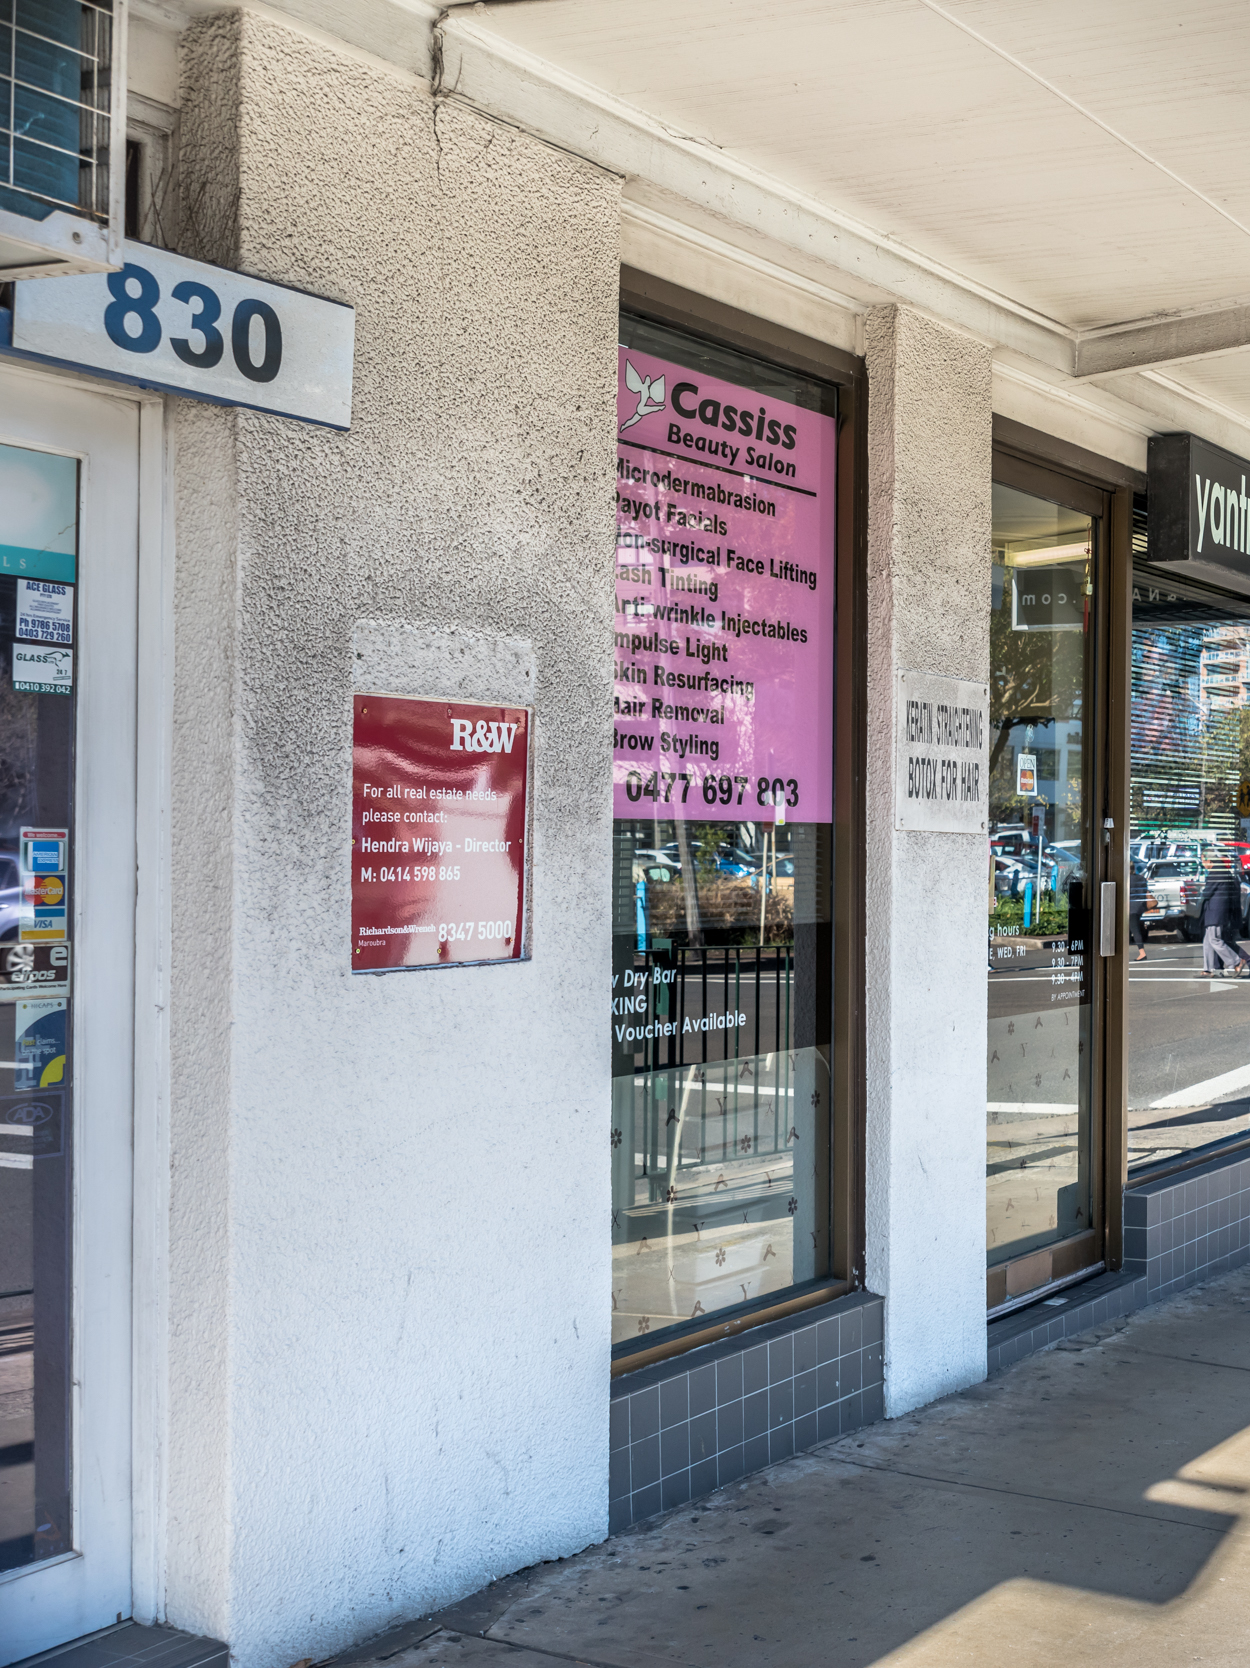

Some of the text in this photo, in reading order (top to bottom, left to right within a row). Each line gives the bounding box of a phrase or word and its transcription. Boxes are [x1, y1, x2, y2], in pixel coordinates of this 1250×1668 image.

[104, 262, 283, 383] 830
[670, 382, 797, 450] Cassiss
[667, 423, 796, 477] Beauty Salon
[667, 503, 727, 536] Facials
[727, 548, 764, 576] Face
[770, 559, 817, 590] Lifting
[26, 581, 66, 596] ACE GLASS
[616, 563, 718, 602] ash Tinting
[18, 627, 71, 642] 0403 729 260
[19, 617, 70, 633] Ph 9786 5708
[721, 610, 808, 643] Injectables
[16, 652, 48, 663] GLASS
[614, 631, 728, 665] mpulse Light
[20, 682, 70, 694] 0410 392 042
[654, 665, 754, 701] Resurfacing
[652, 697, 725, 724] Removal
[450, 718, 517, 754] R&W
[659, 731, 719, 761] Styling
[1019, 757, 1035, 769] OPEN
[625, 770, 799, 807] 0477 697 803
[908, 756, 979, 802] BOTOX FOR HAIR
[363, 783, 497, 801] For all real estate needs
[362, 808, 448, 825] please contact:
[361, 837, 409, 853] Hendra
[412, 837, 453, 856] Wijaya
[464, 837, 511, 853] Director
[361, 865, 461, 882] M: 0414 598 865
[24, 887, 63, 895] MasterCard
[34, 919, 53, 928] VISA
[438, 921, 475, 942] 8347
[477, 920, 512, 940] 5000
[997, 923, 1020, 937] hours
[358, 939, 386, 947] Maroubra
[1016, 945, 1026, 957] FRI
[11, 970, 56, 983] eftpos
[623, 969, 649, 990] Dry
[653, 966, 677, 985] Bar
[615, 1009, 747, 1043] Voucher Available
[43, 1047, 56, 1055] spot
[13, 1106, 46, 1122] ADA
